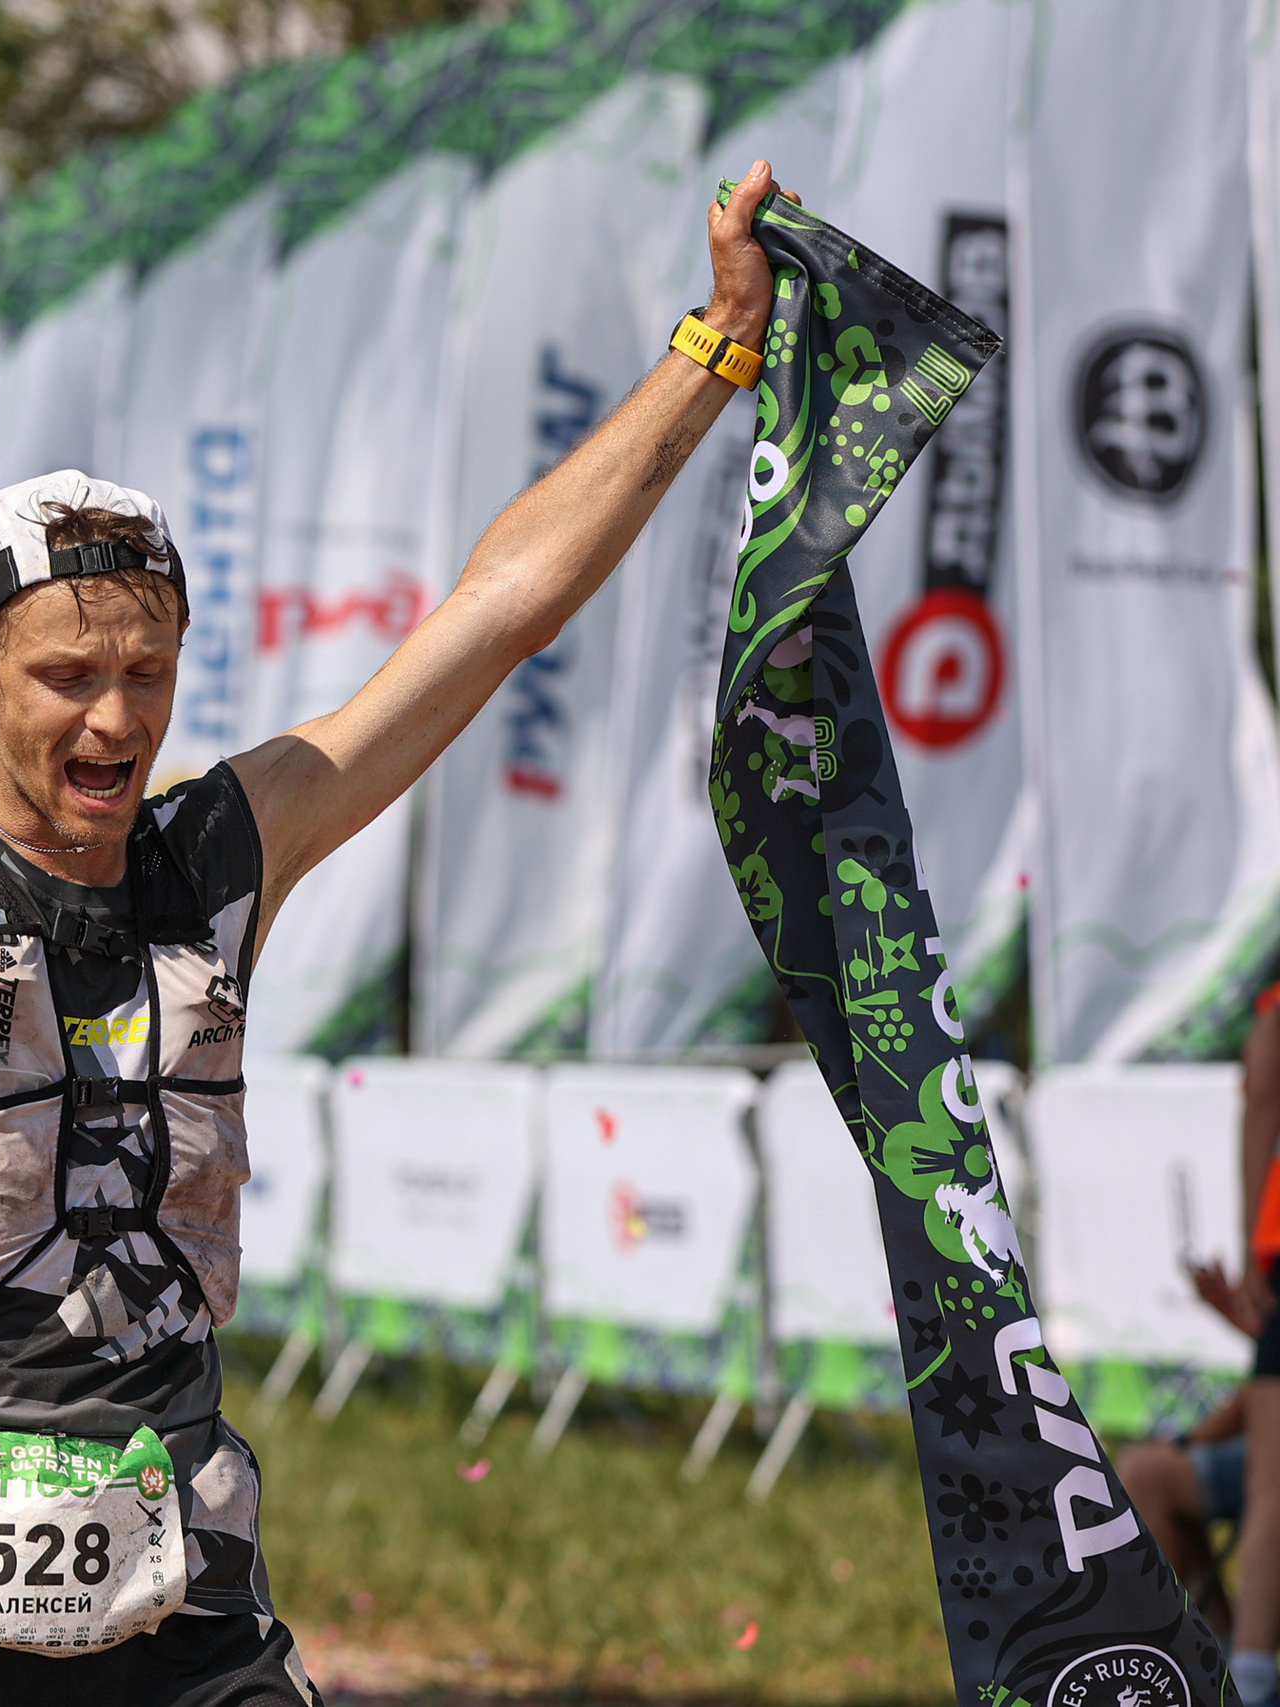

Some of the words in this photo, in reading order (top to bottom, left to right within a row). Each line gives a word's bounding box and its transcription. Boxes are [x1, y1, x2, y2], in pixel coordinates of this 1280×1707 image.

[62, 1015, 151, 1046] TERRE
[10, 1458, 70, 1478] ULTRA
[11, 1444, 103, 1471] GOLDEN
[149, 1555, 162, 1563] XS
[1094, 1658, 1171, 1694] RUSSIA
